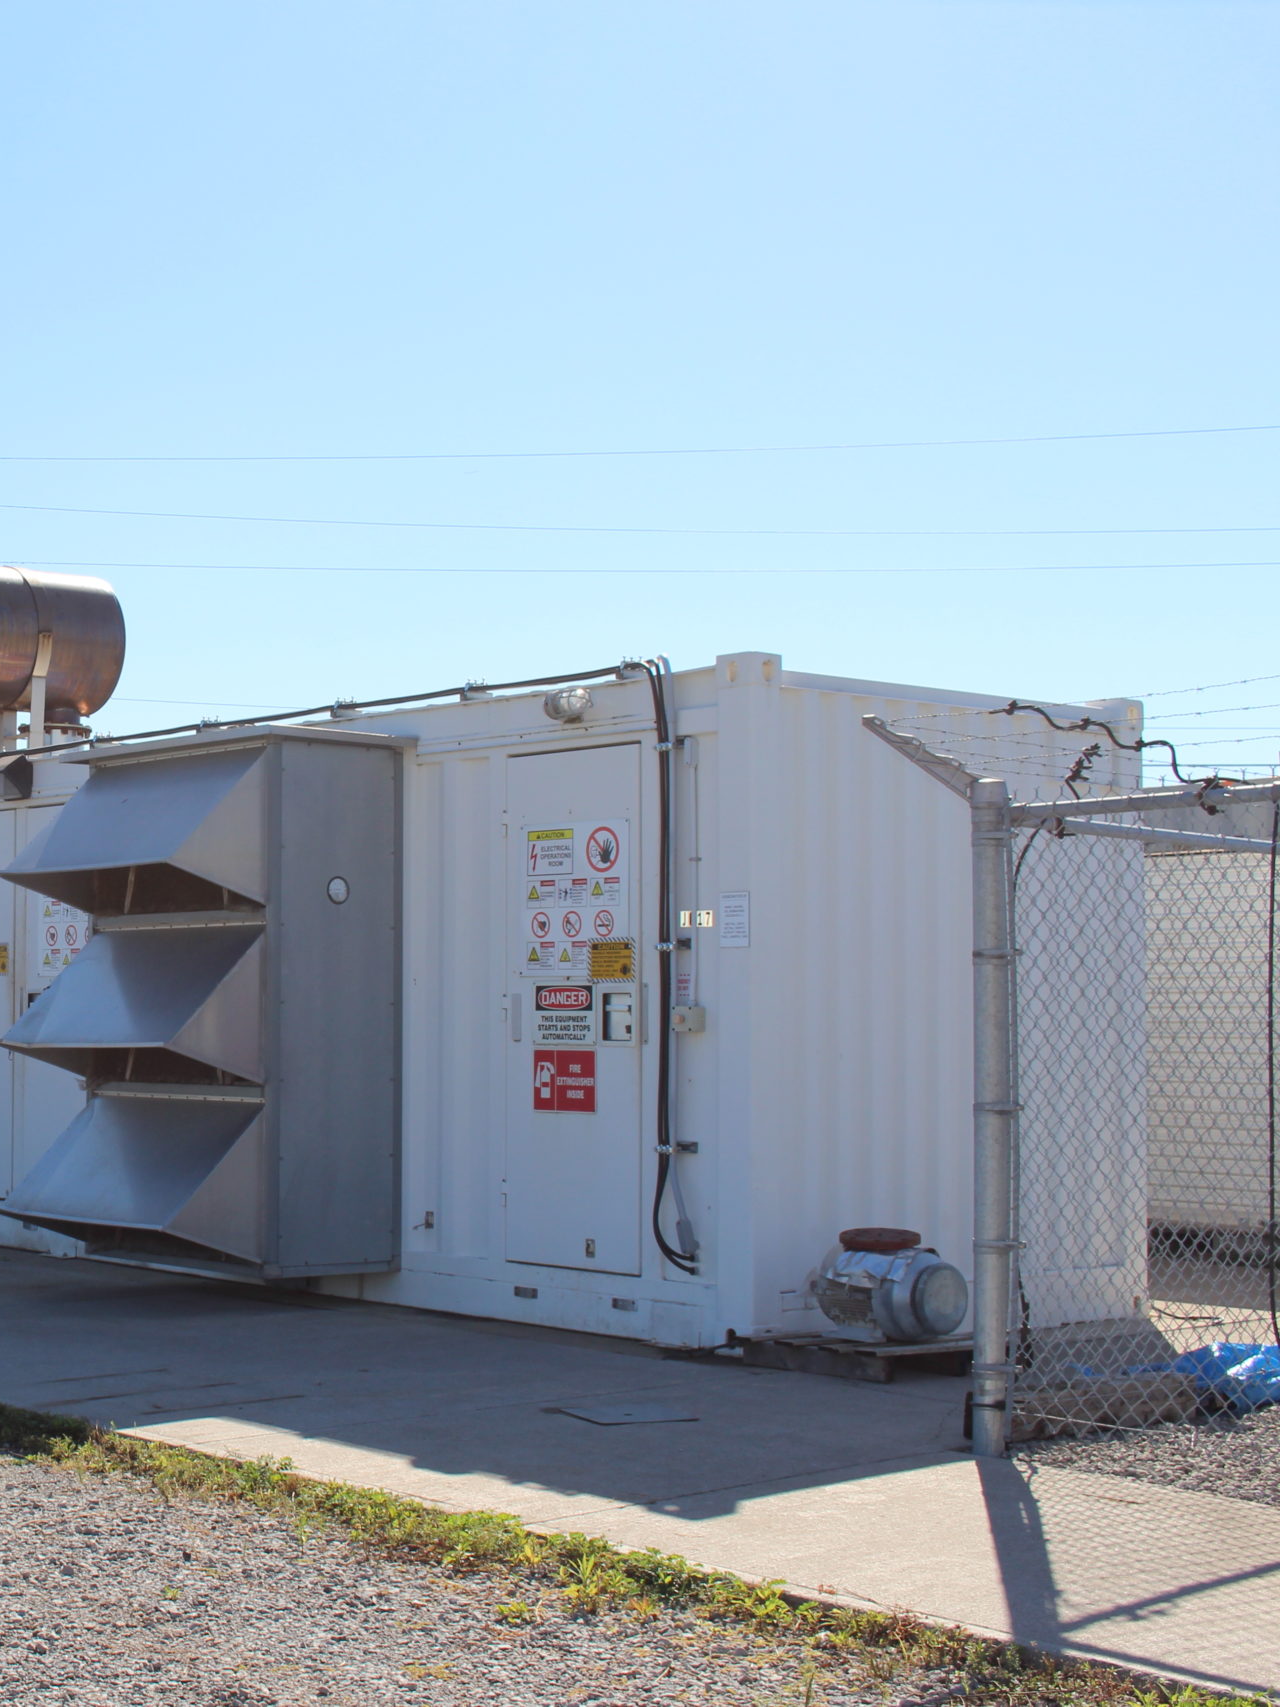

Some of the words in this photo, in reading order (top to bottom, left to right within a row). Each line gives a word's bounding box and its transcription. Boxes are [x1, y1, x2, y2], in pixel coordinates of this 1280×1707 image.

[541, 991, 586, 1005] DANGER
[541, 1015, 554, 1023] THIS
[555, 1015, 587, 1023] EQUIPMENT
[538, 1024, 558, 1032] STARTS
[572, 1024, 591, 1032] STOPS
[542, 1033, 586, 1041] AUTOMATICALLY
[569, 1064, 582, 1073] FIRE
[556, 1076, 594, 1086] EXTINGUISHER
[566, 1089, 585, 1099] INSIDE
